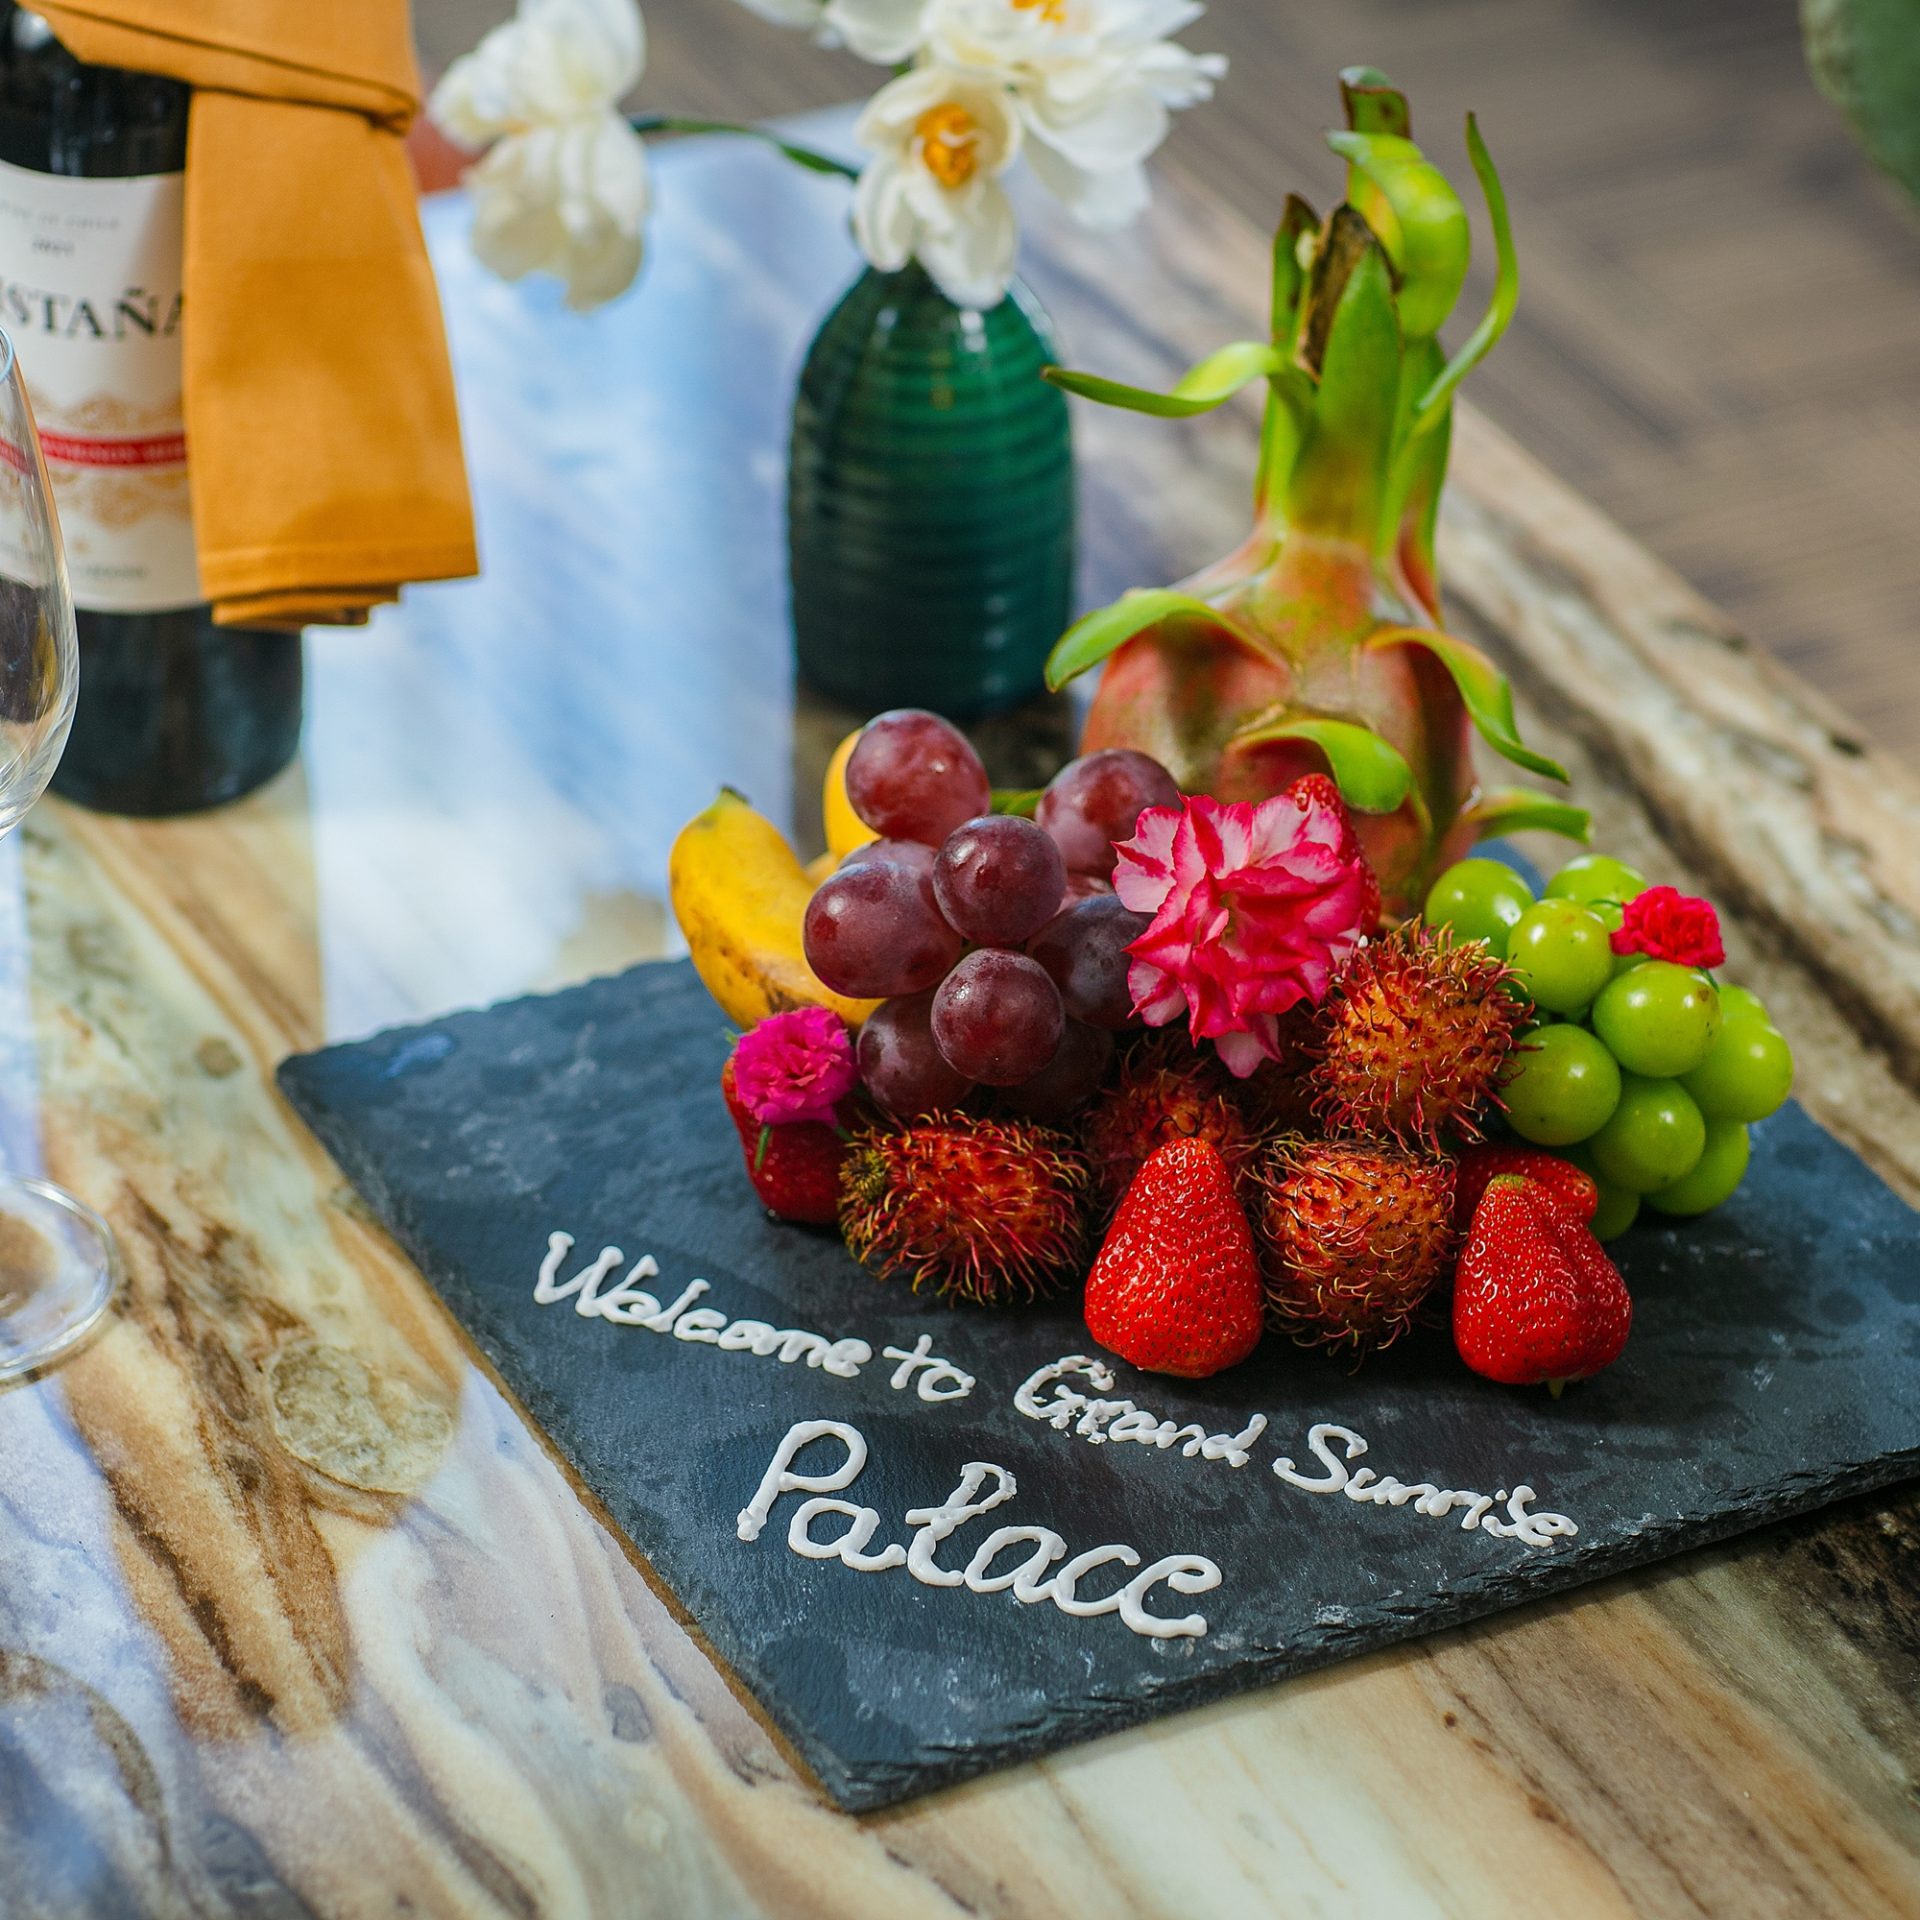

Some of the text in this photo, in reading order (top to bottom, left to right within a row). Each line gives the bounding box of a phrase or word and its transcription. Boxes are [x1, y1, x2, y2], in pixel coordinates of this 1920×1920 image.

[0, 278, 185, 340] STAÑA
[534, 1231, 1579, 1547] Welcome to Grand Sunrise
[736, 1419, 1223, 1637] Palace
